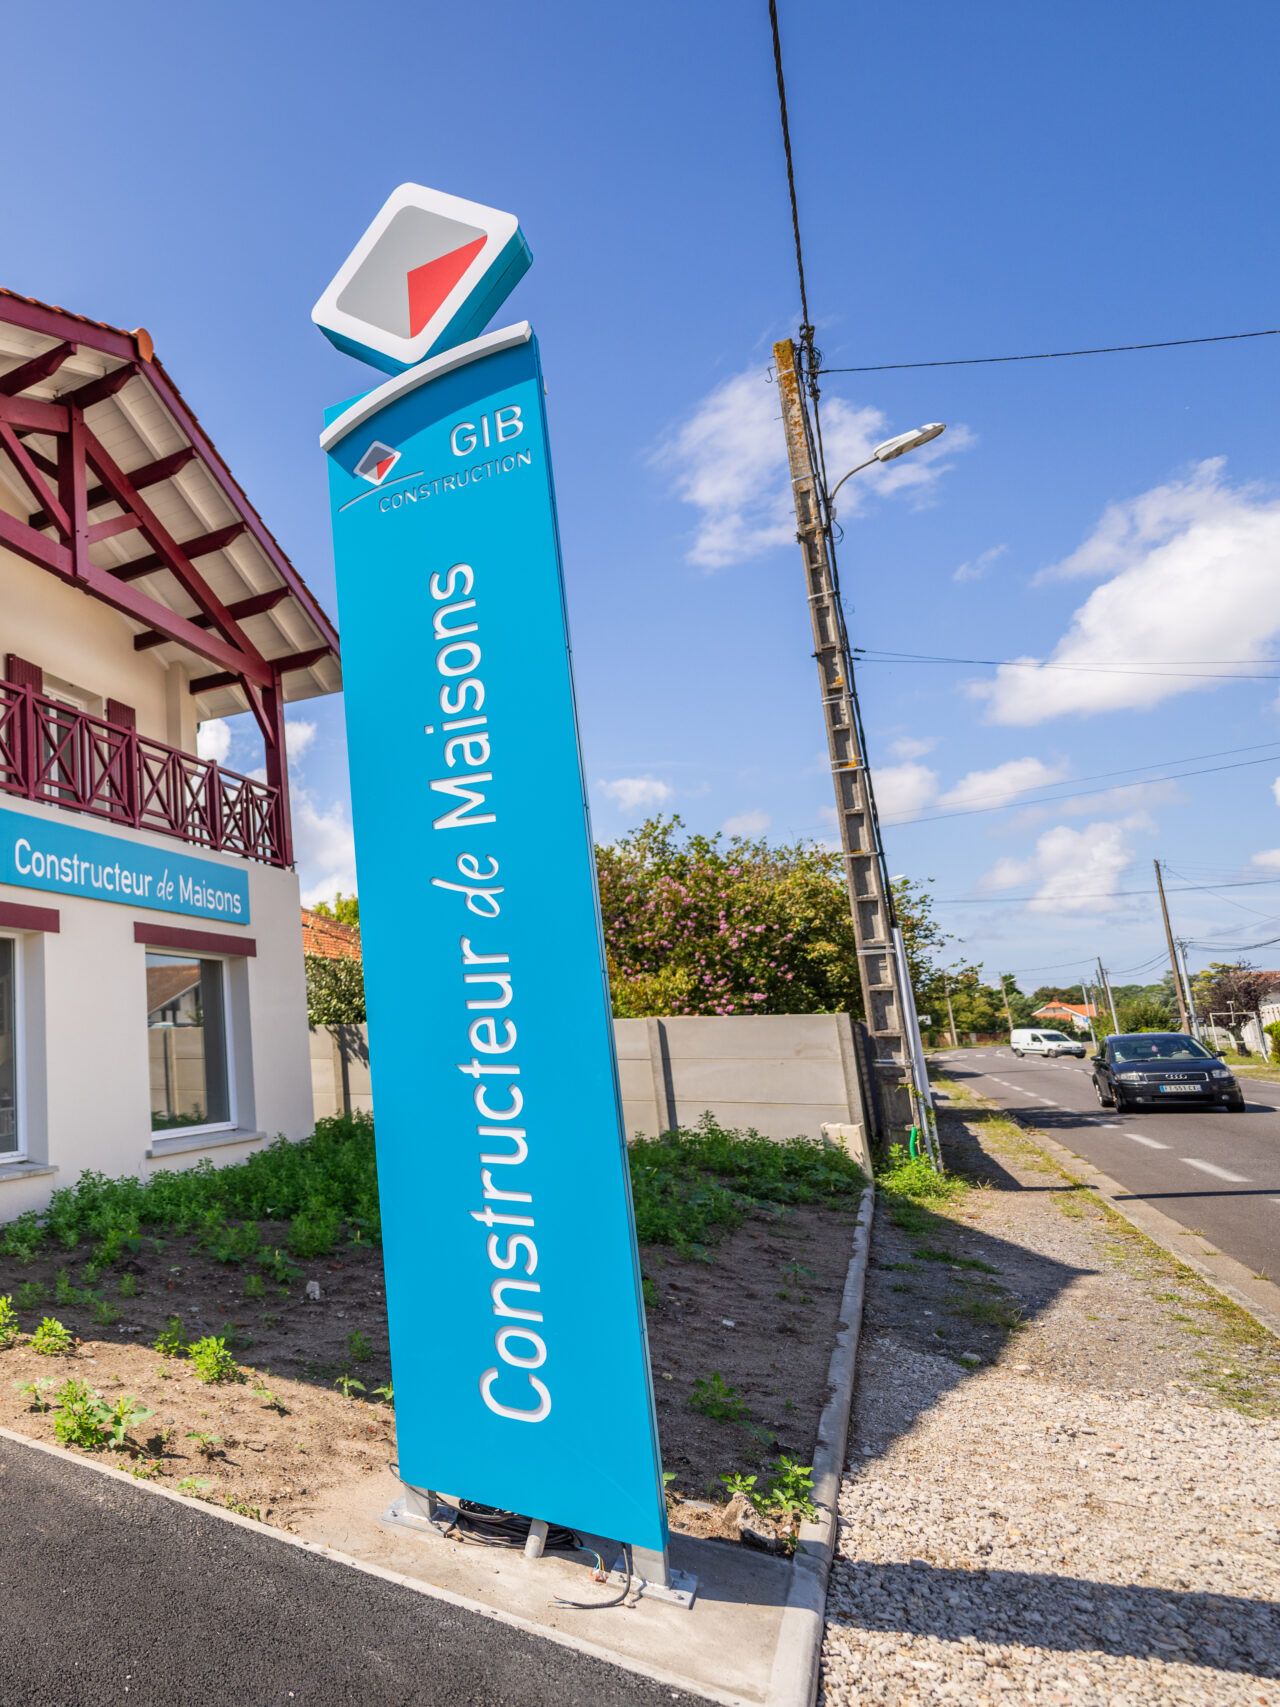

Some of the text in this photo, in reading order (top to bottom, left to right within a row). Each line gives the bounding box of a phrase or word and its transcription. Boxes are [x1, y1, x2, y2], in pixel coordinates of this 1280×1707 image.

[449, 403, 524, 457] GIB
[378, 448, 532, 512] CONSTRUCTION
[14, 838, 242, 914] Constructeur de Maisons
[424, 562, 552, 1424] Constructeur de Maisons
